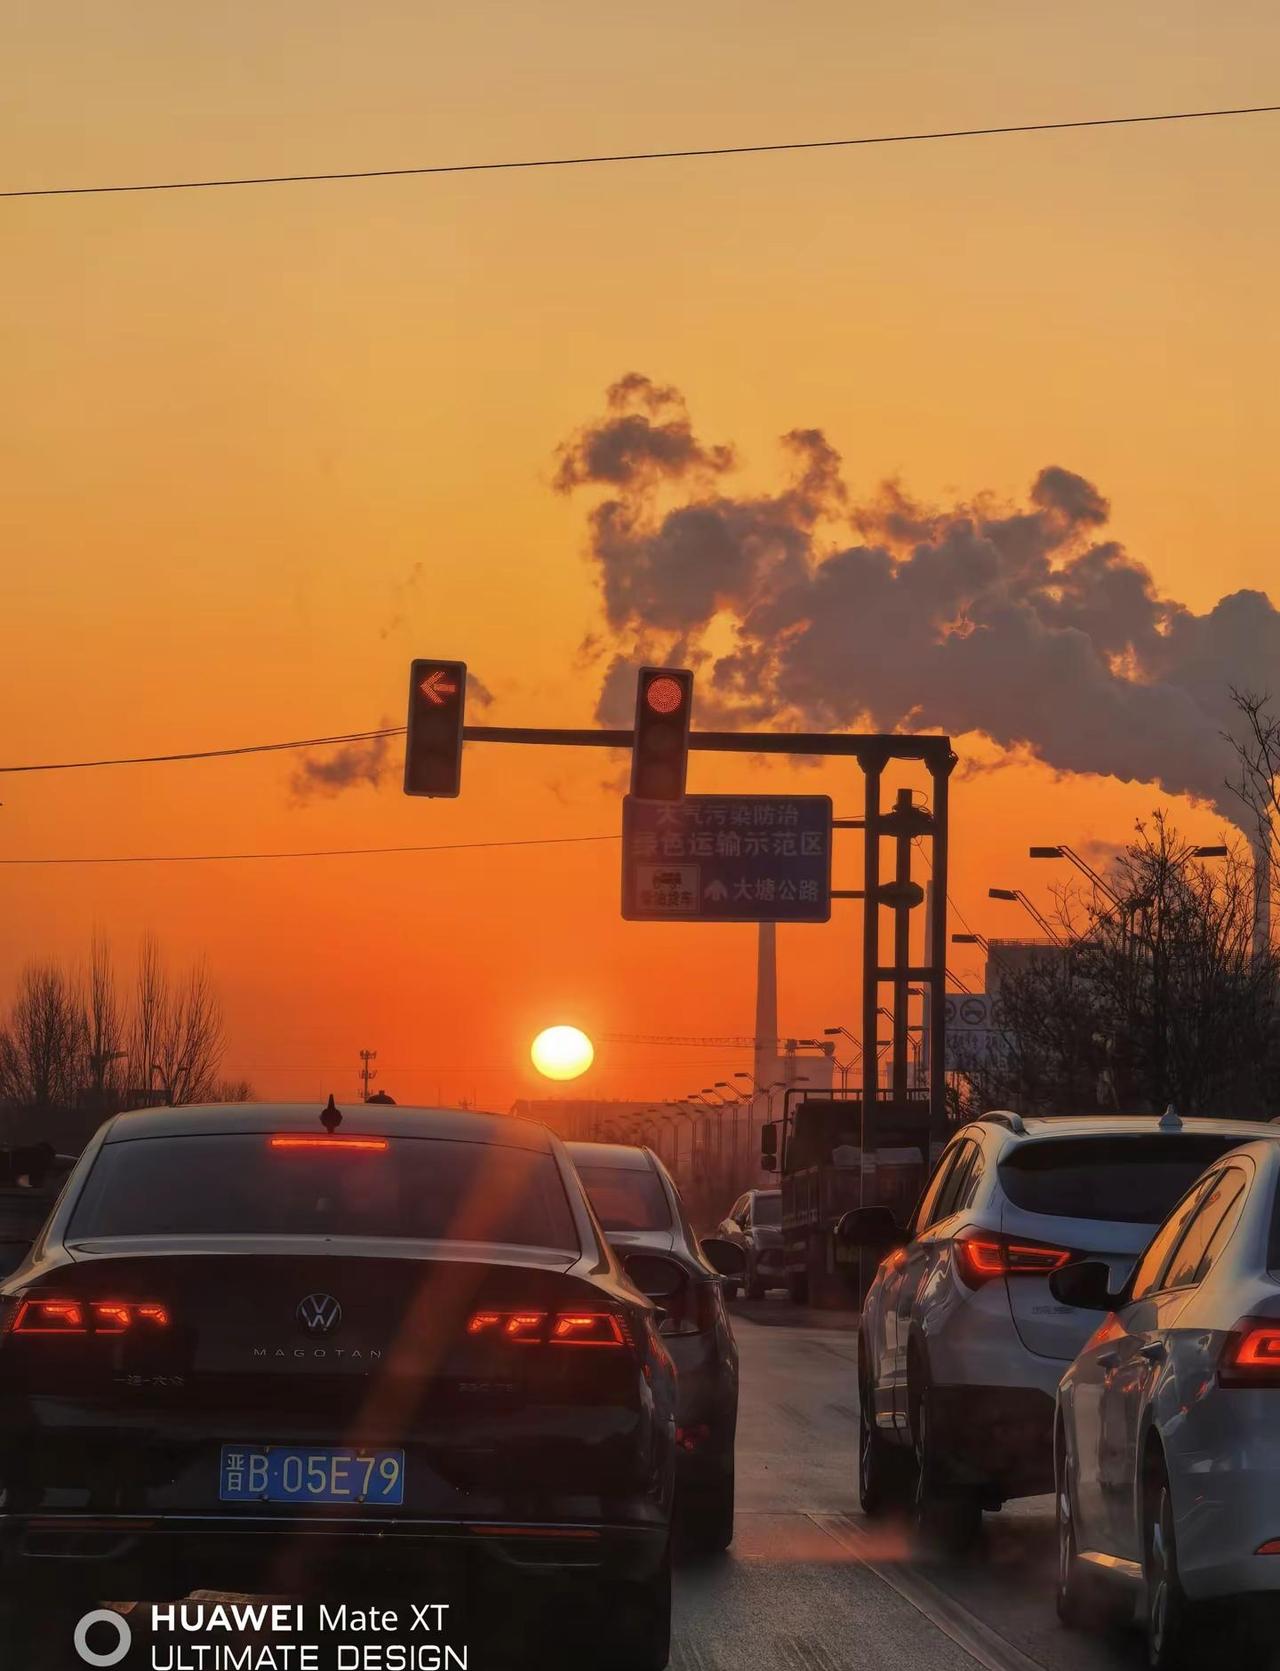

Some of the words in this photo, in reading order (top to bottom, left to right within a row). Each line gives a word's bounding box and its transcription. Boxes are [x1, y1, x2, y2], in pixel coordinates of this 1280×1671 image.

[656, 803, 799, 825] 大气污染防治
[733, 879, 819, 902] 大塘公路
[253, 1348, 382, 1359] MAGOTAN
